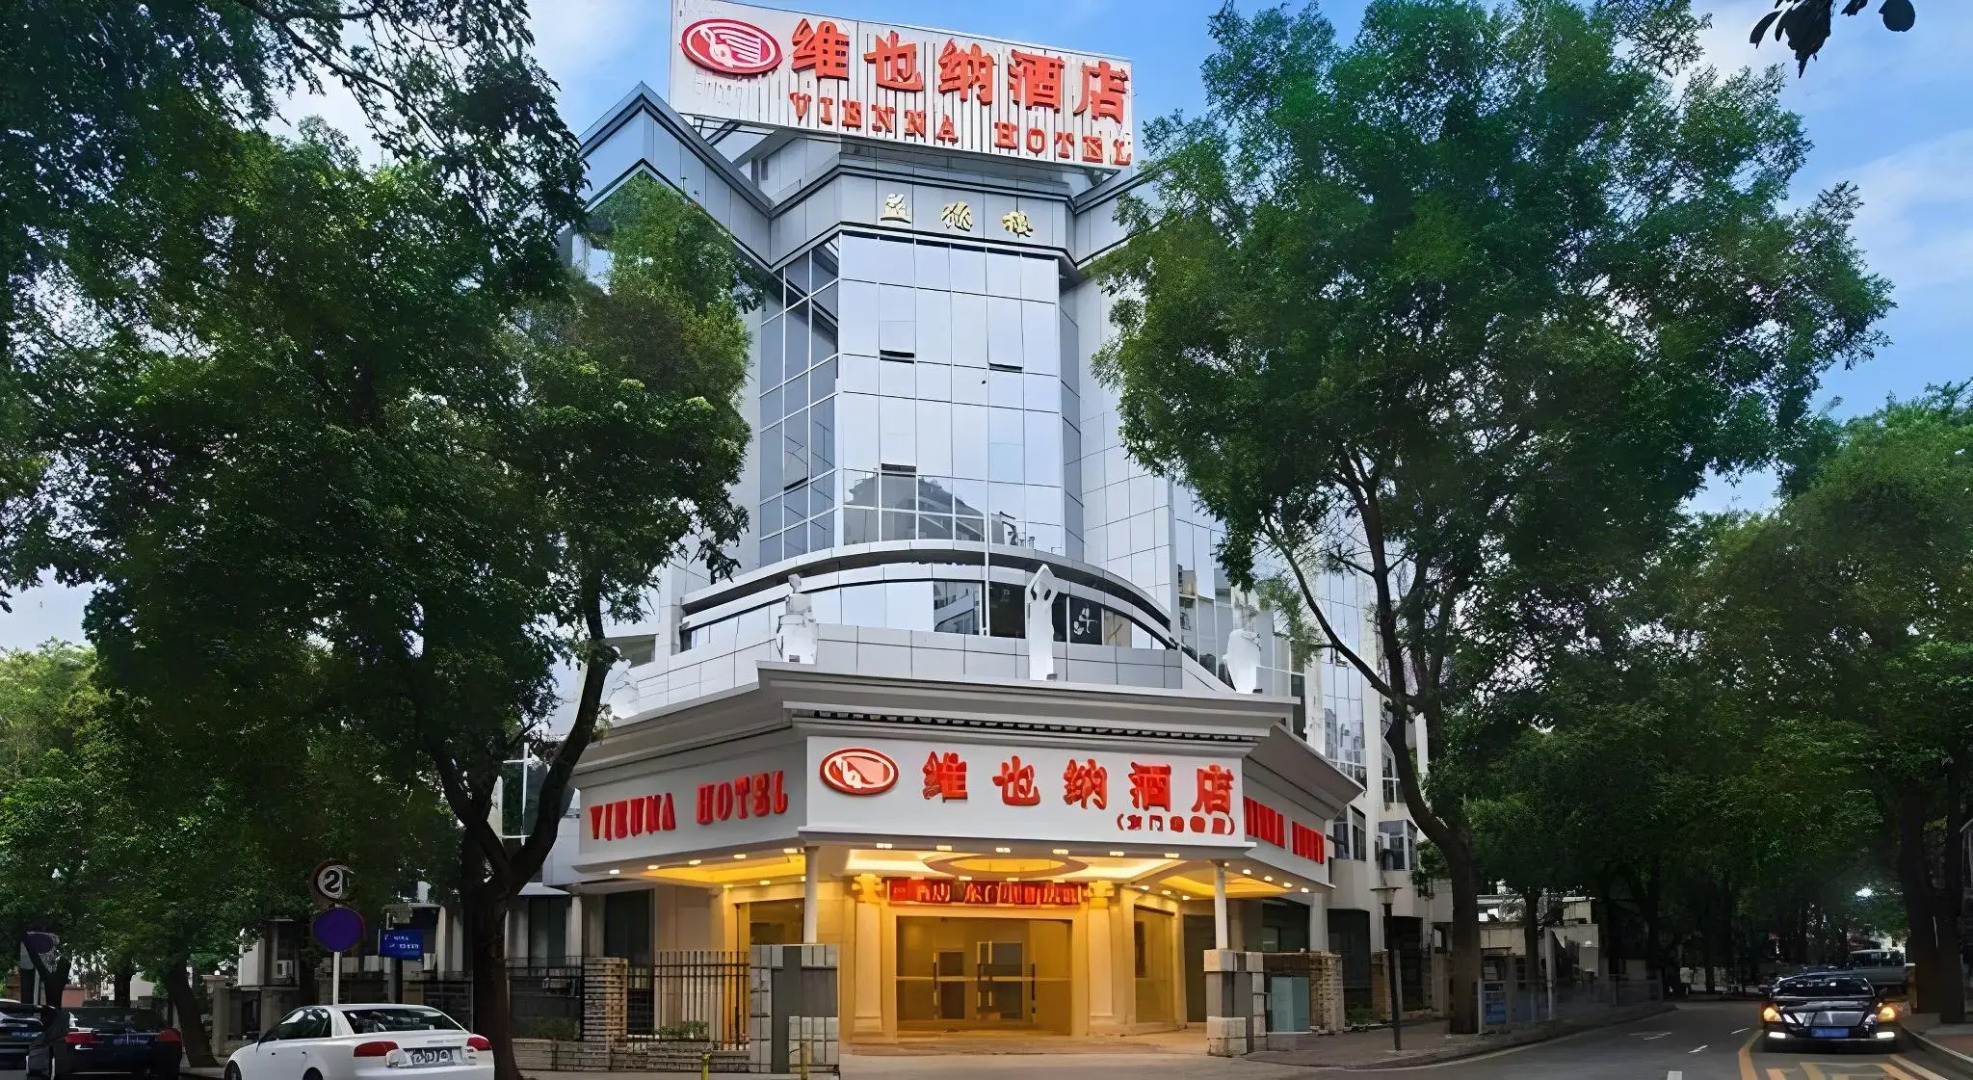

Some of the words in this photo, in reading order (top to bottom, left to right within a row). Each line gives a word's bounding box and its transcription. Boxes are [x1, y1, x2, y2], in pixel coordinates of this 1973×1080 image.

[790, 18, 1131, 125] 维也纳酒店
[922, 751, 1235, 815] 维也纳酒店
